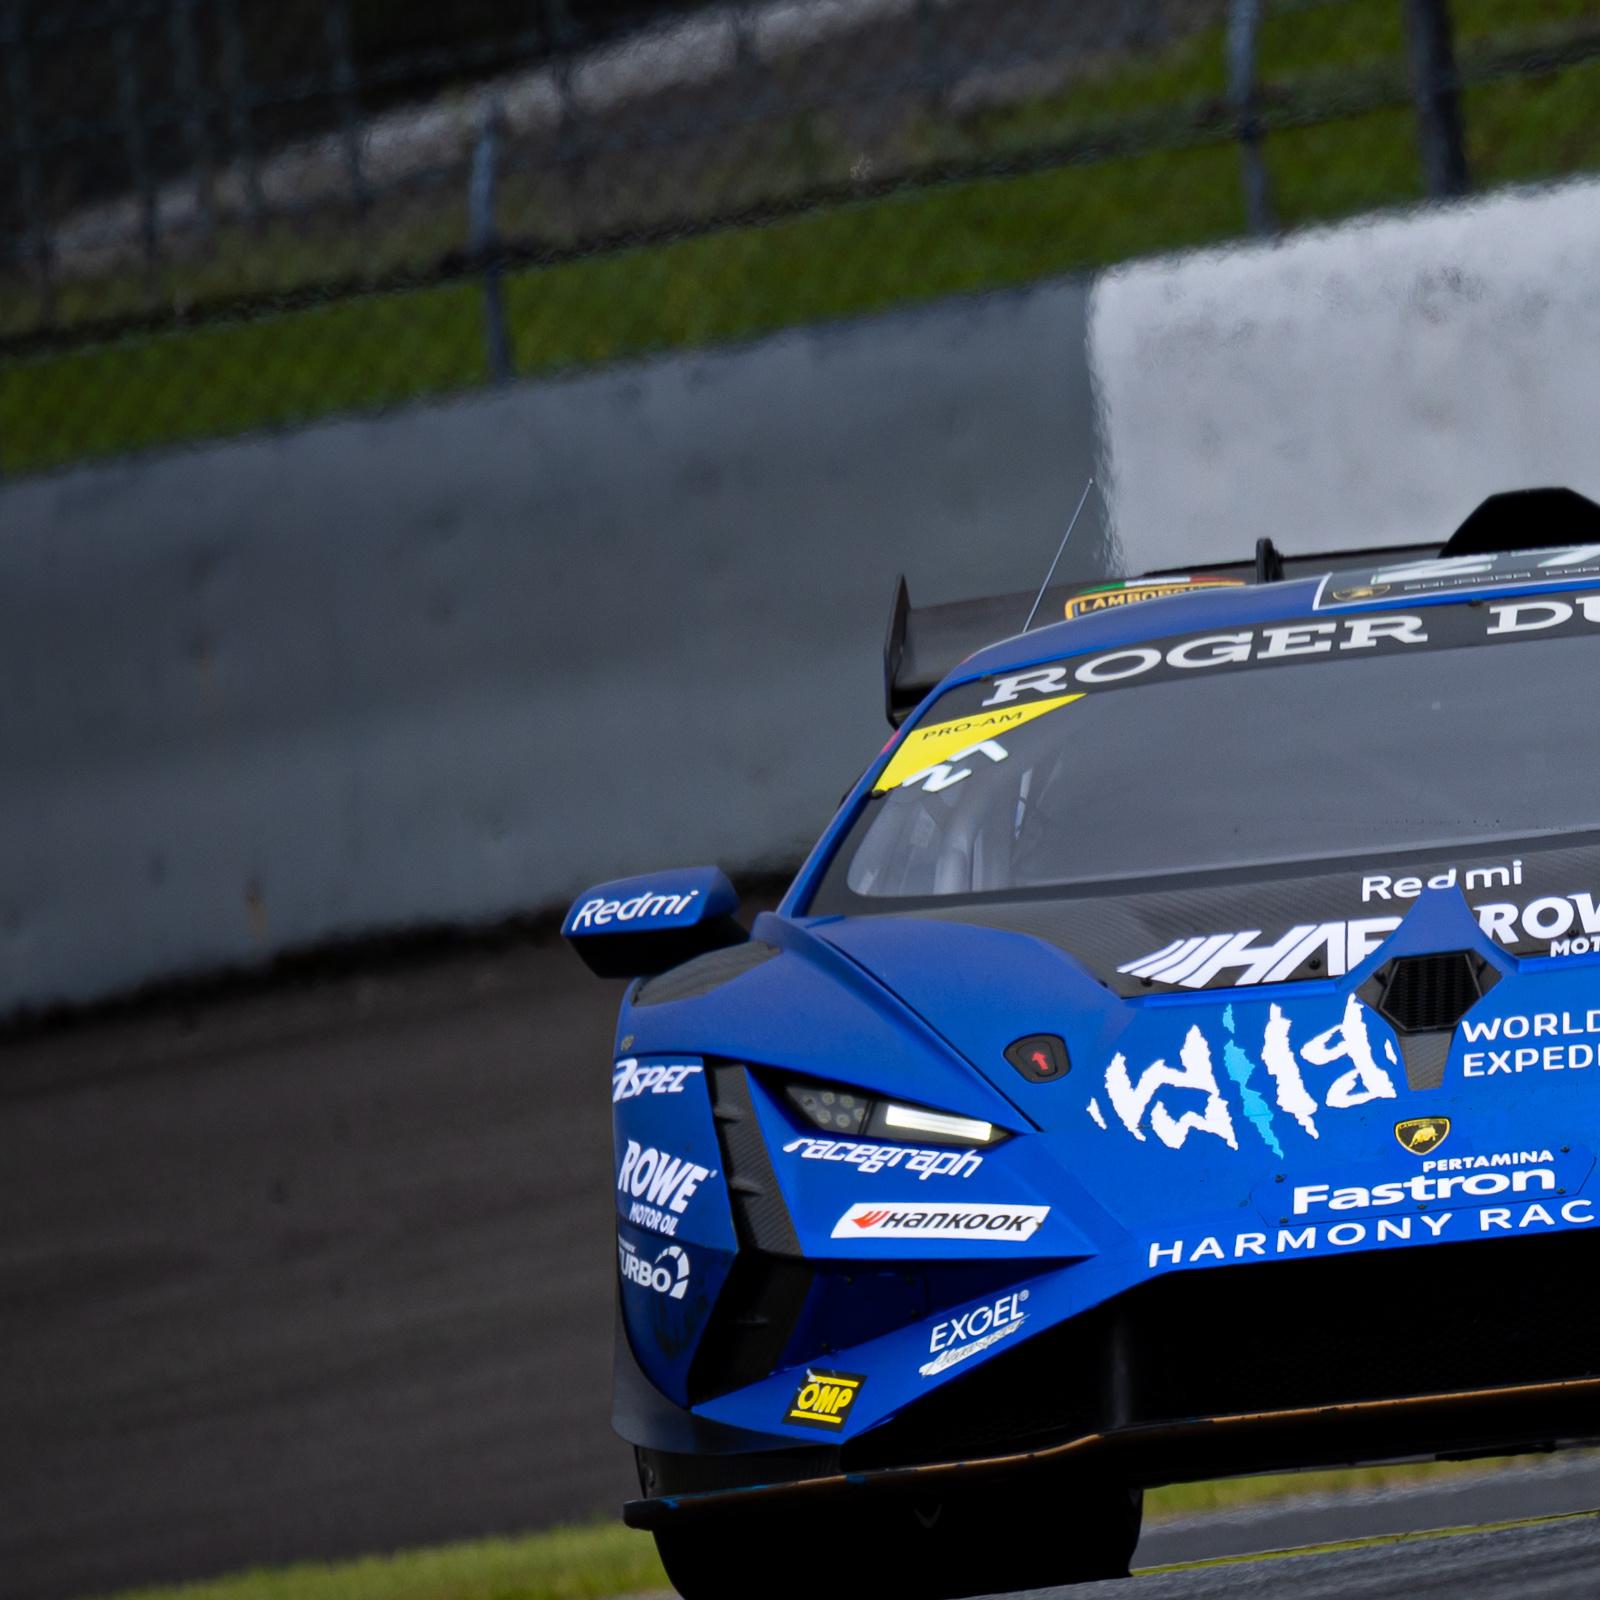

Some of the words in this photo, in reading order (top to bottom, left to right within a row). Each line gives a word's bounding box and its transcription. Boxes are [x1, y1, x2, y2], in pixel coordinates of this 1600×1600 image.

[981, 614, 1428, 706] ROGER
[922, 711, 1024, 741] PRO-AM
[1361, 859, 1523, 902] Redmi
[570, 889, 698, 931] Redmi
[618, 1139, 710, 1214] ROWE
[783, 1137, 984, 1181] racegraph
[1422, 1149, 1555, 1173] PERTAMINA
[1292, 1165, 1556, 1216] Fastron
[629, 1202, 662, 1232] MOTOR
[1147, 1211, 1454, 1268] HARMONY
[798, 1383, 853, 1414] OMP
